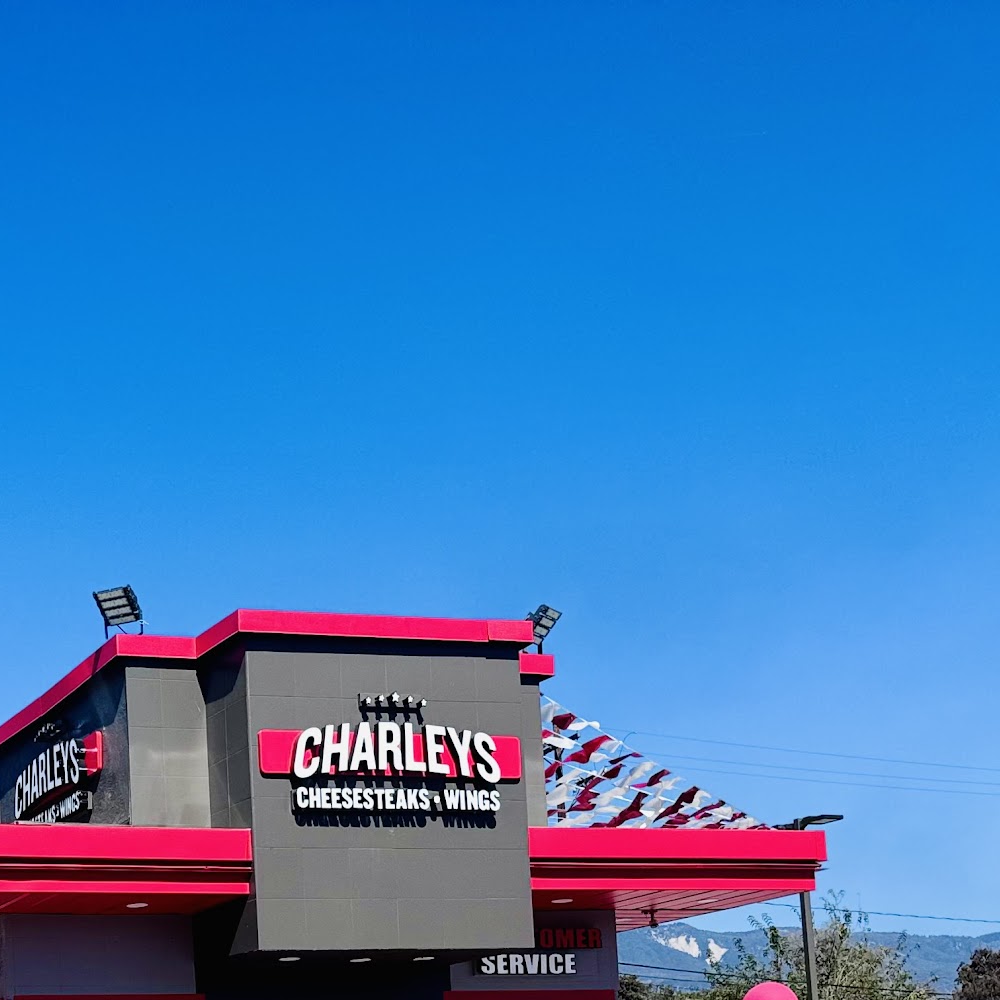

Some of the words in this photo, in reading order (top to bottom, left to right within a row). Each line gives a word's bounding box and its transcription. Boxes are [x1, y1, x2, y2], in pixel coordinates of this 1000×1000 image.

[293, 721, 501, 783] CHARLEYS
[15, 738, 79, 819] CHARLEYS
[59, 791, 81, 819] WINGS
[296, 786, 430, 811] CHEESESTEAKS
[443, 788, 501, 812] WINGS
[539, 928, 602, 949] OMER
[481, 953, 577, 975] SERVICE
